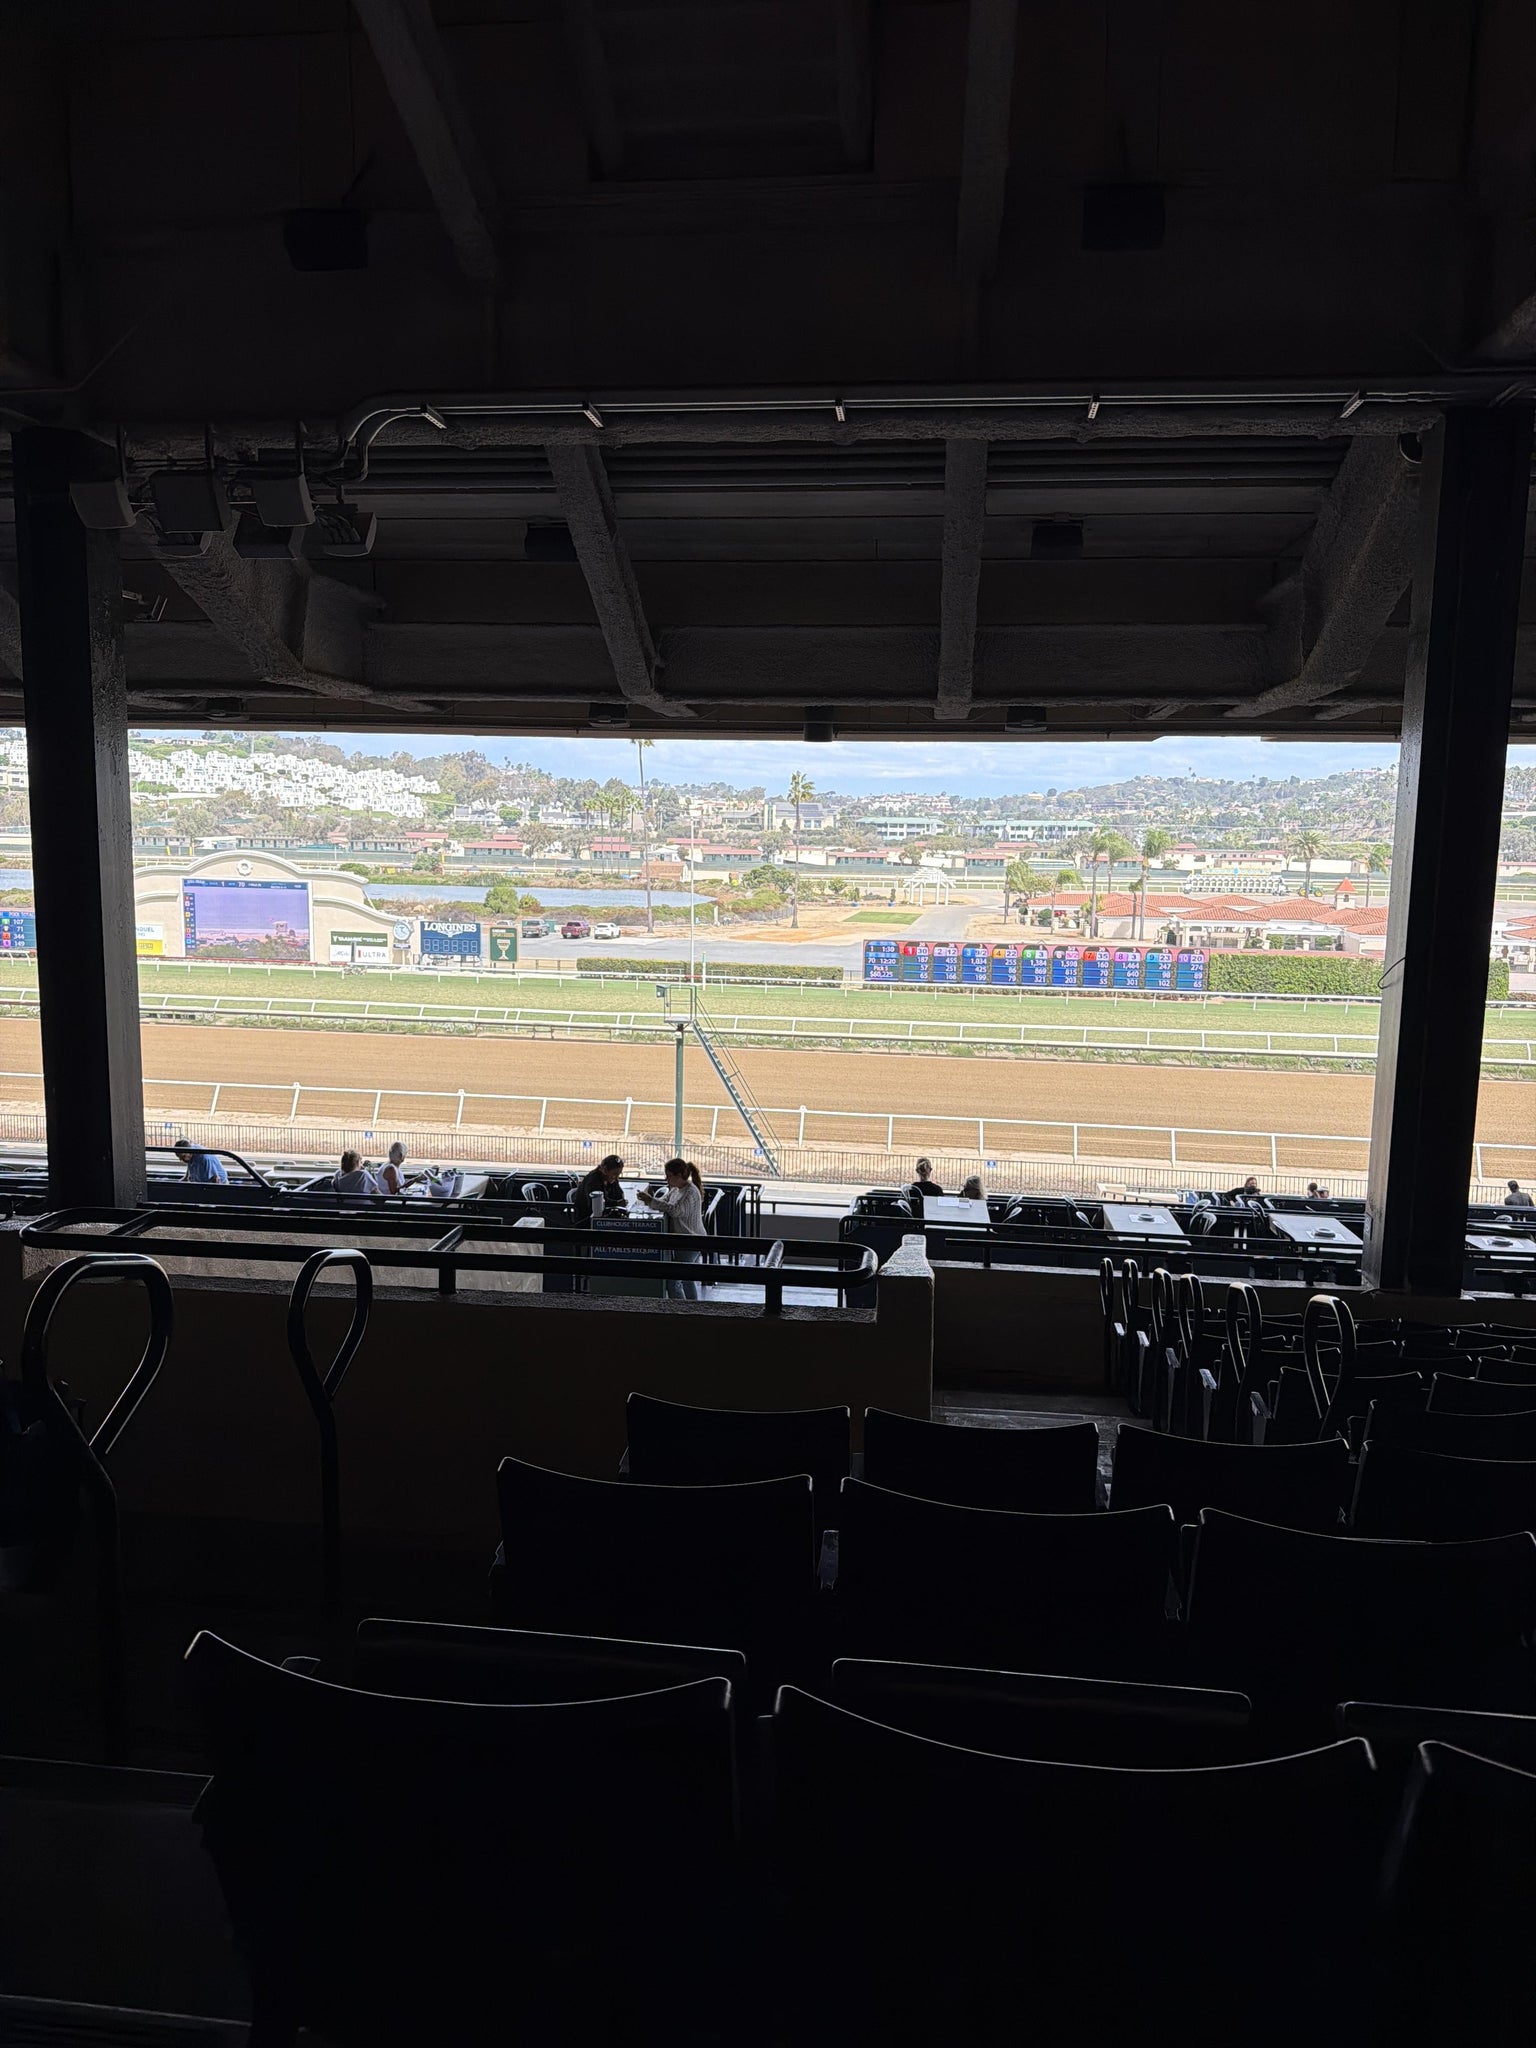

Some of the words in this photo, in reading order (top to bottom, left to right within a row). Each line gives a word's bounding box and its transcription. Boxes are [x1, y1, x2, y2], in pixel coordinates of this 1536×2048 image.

[423, 922, 477, 933] LONGINES
[1122, 962, 1139, 970] 1,464
[596, 1220, 630, 1228] CLUBHOUSE
